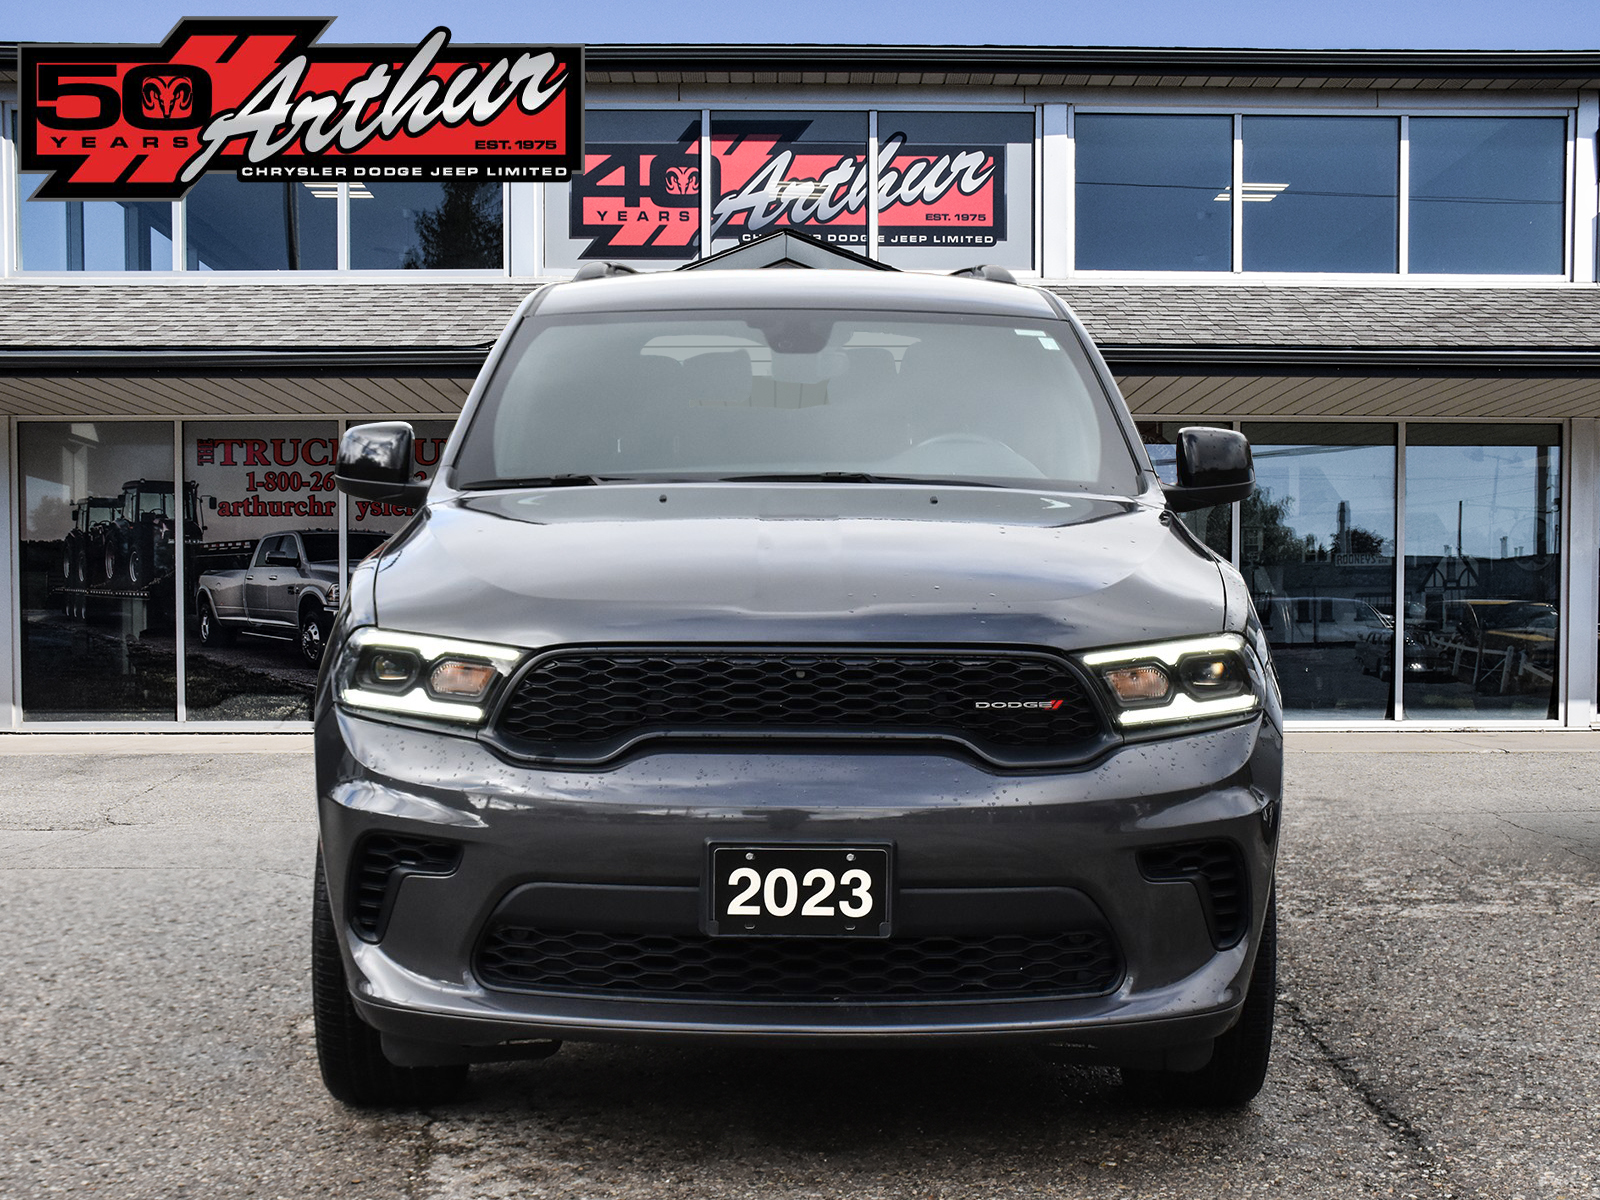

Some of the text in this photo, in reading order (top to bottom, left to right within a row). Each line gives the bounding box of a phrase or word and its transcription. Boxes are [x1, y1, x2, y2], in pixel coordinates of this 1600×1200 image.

[692, 142, 996, 247] Arthur
[597, 211, 690, 222] YEARS
[925, 213, 987, 222] EST. 1975
[891, 235, 928, 243] JEEP
[933, 235, 994, 244] LIMITED
[196, 438, 215, 466] THE
[975, 701, 1053, 709] DODGE
[726, 867, 874, 918] 2023
